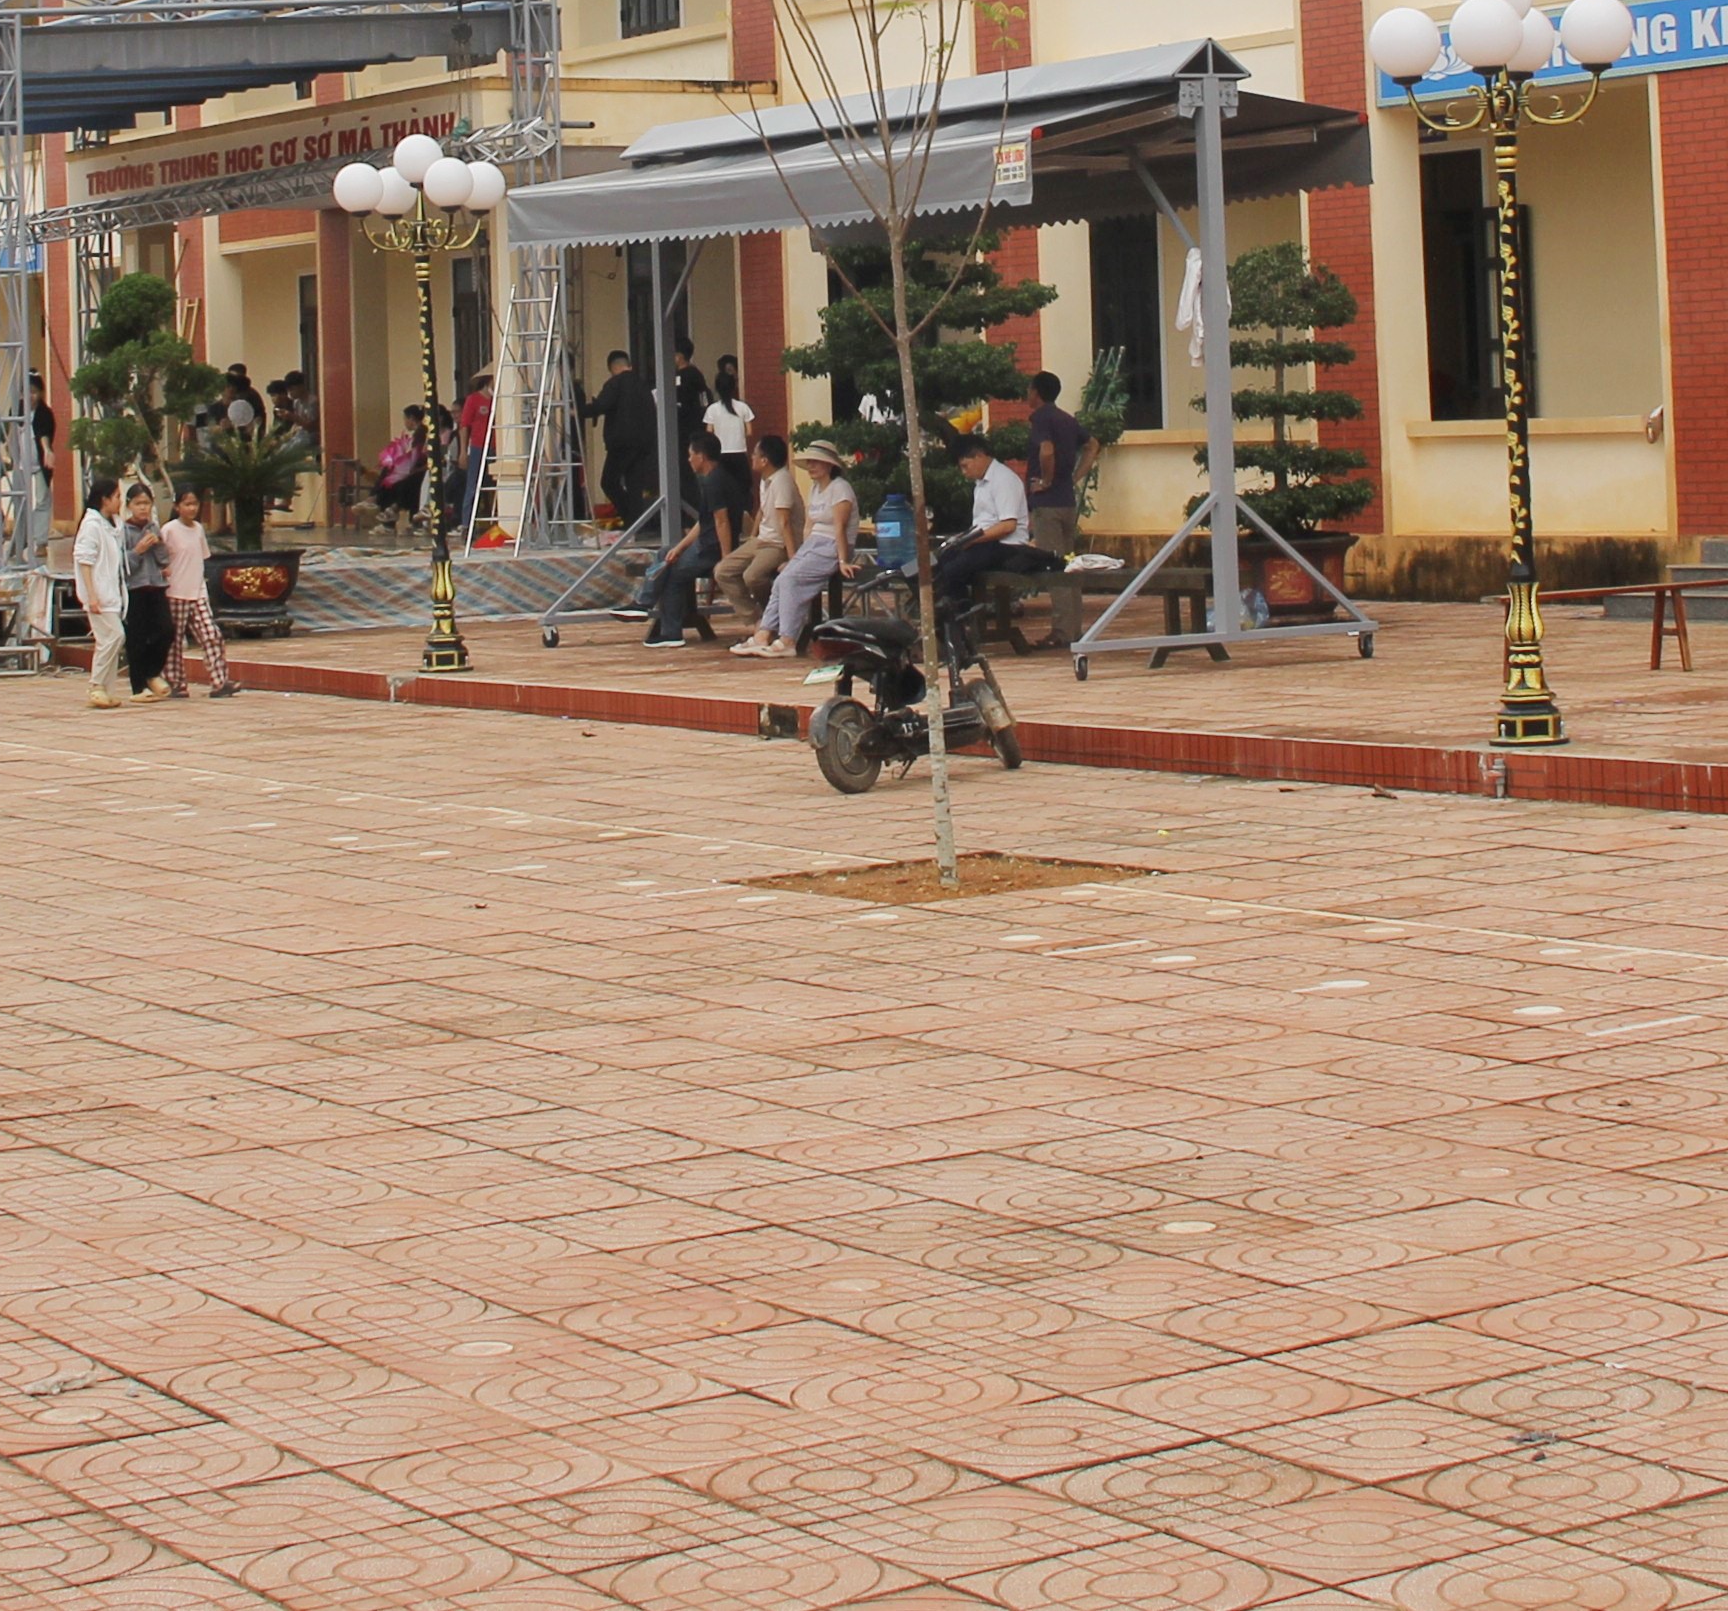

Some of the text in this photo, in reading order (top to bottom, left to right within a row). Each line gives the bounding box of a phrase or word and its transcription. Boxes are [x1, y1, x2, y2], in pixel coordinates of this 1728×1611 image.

[86, 155, 155, 196] TRƯỜNG
[158, 151, 219, 186] TRUNG
[269, 136, 298, 167] CƠ
[303, 117, 333, 162] SỞ
[338, 115, 372, 156] MÃ
